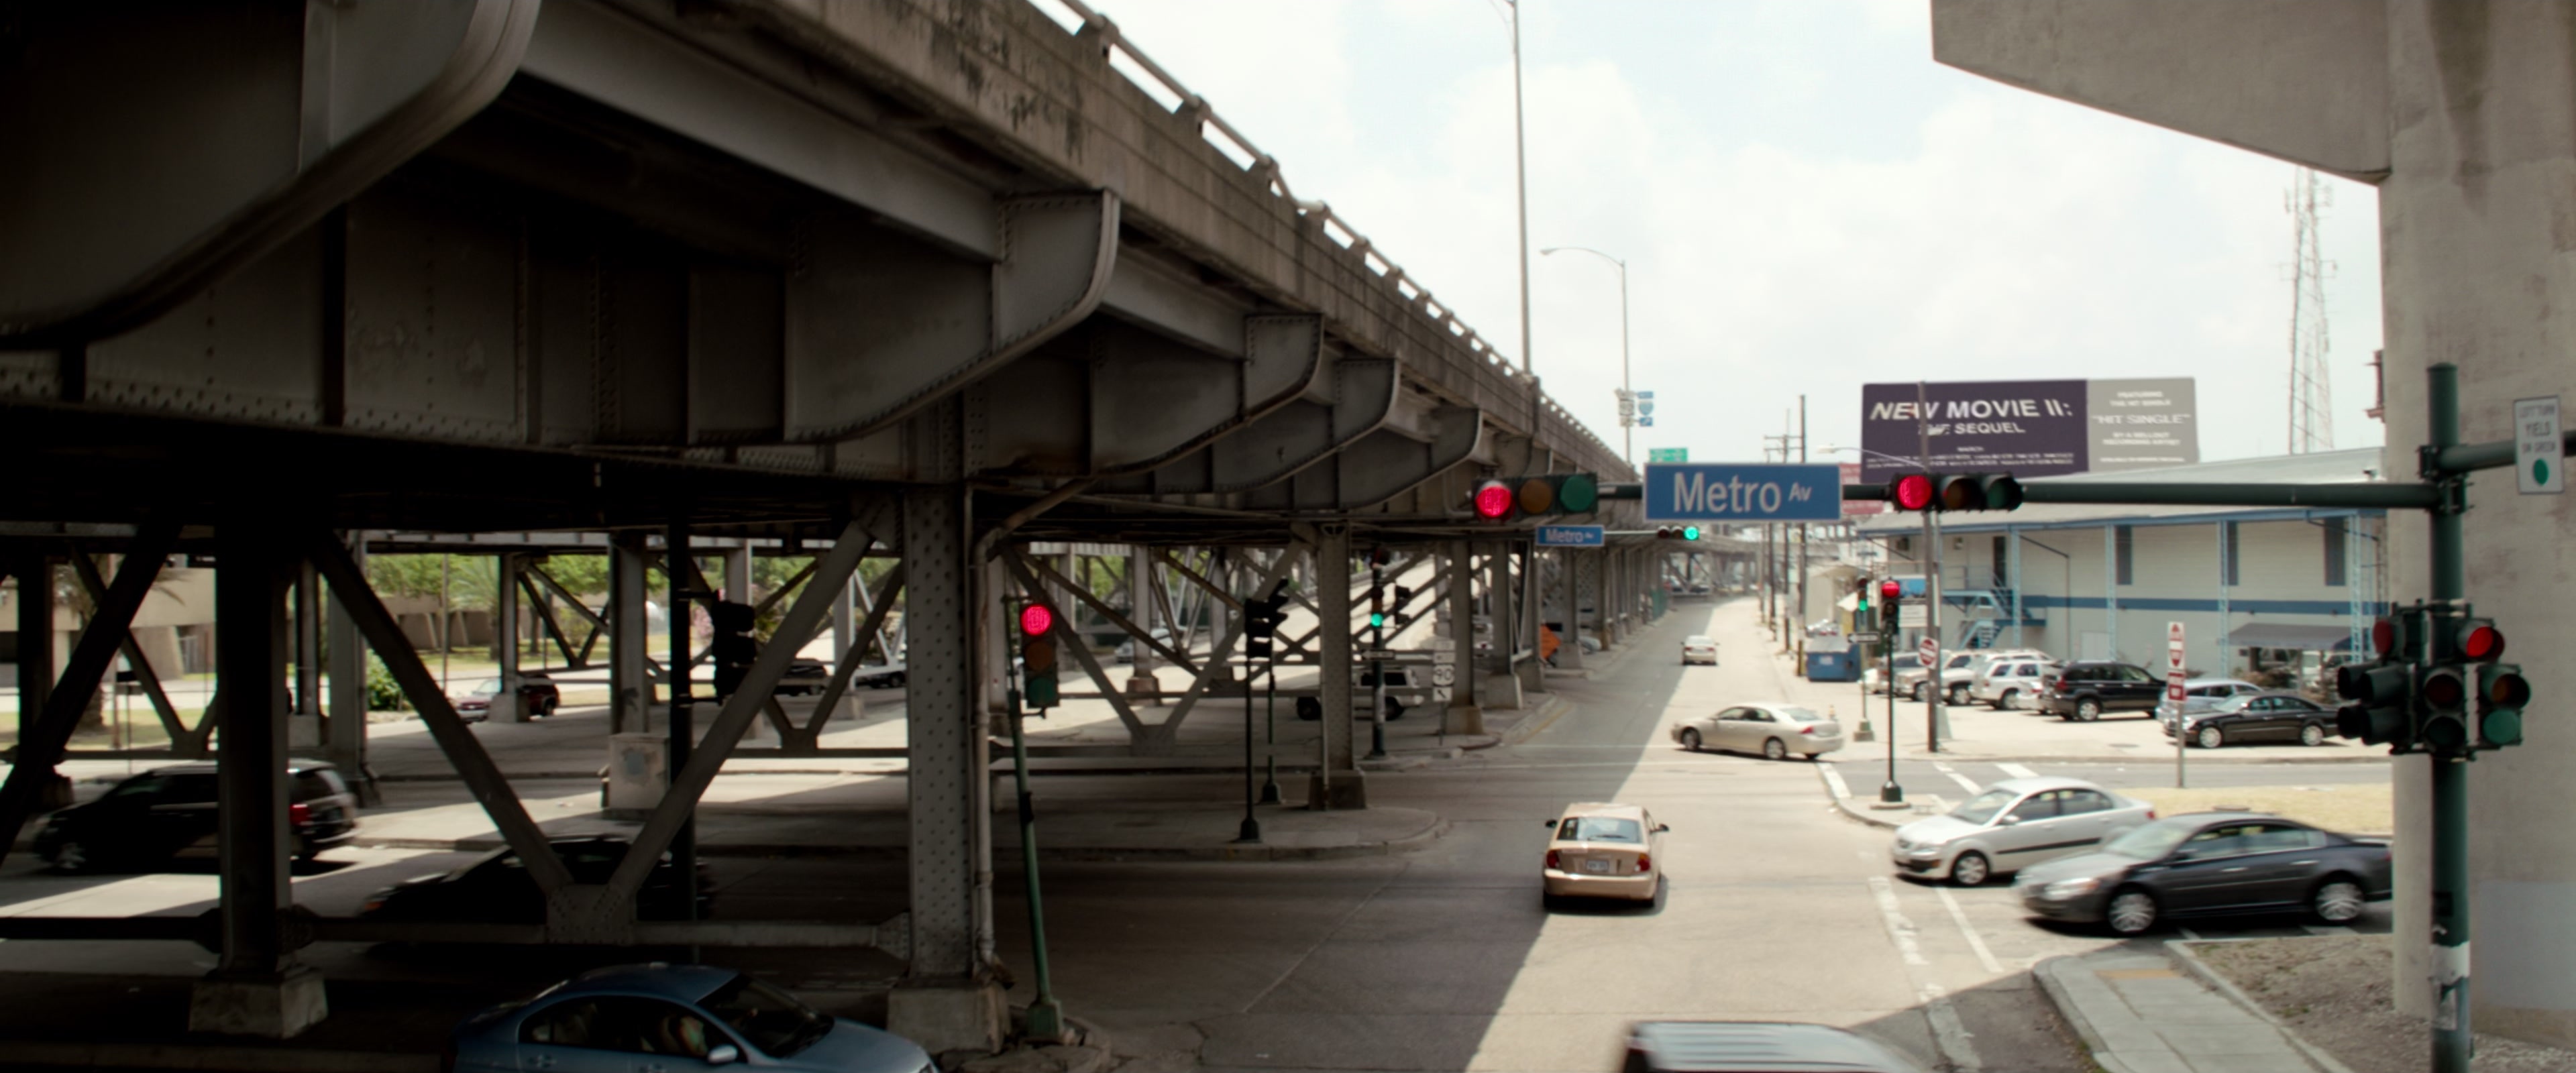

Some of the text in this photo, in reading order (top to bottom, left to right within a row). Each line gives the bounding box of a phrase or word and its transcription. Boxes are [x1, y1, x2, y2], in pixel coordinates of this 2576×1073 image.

[1870, 402, 1939, 420] NEW
[1947, 400, 2040, 418] MOVIE
[1954, 422, 2026, 435] SEQUEL
[1673, 471, 1811, 514] Metro Av
[1545, 528, 1584, 543] Metro
